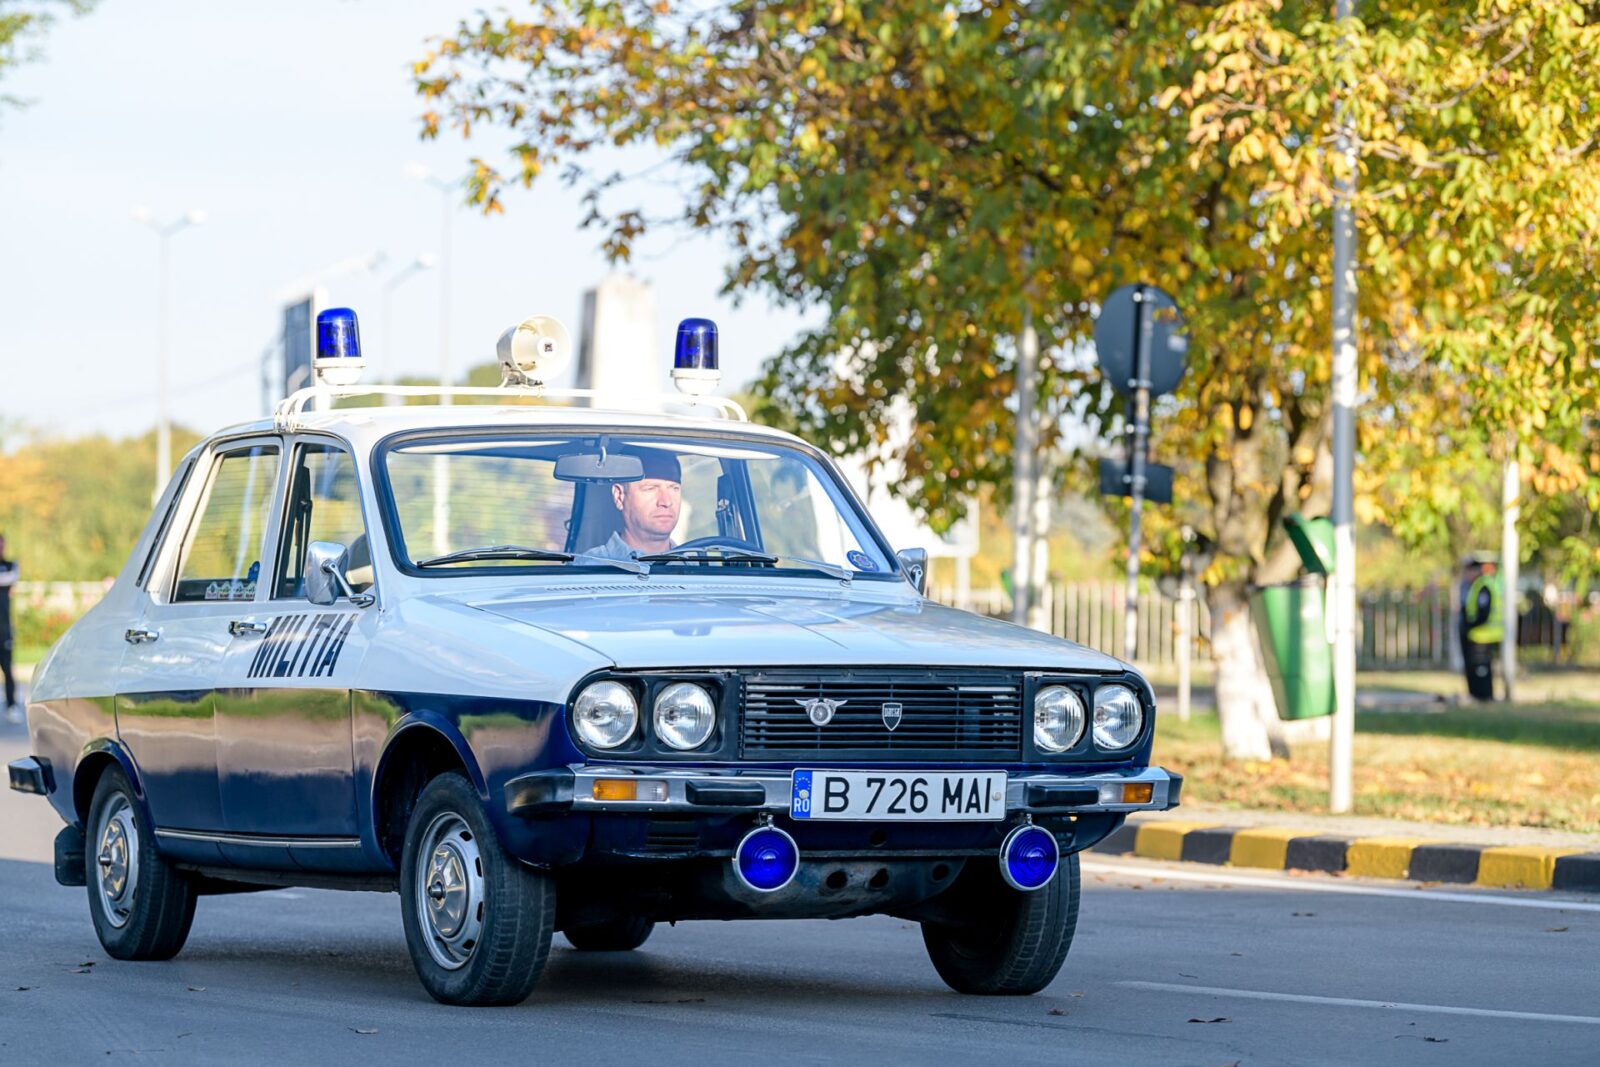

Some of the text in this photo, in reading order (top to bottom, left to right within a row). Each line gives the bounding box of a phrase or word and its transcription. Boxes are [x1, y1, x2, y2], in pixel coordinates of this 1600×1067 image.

[247, 613, 359, 678] MILITIA
[793, 798, 810, 813] RO
[824, 777, 992, 814] B 726 MAI
